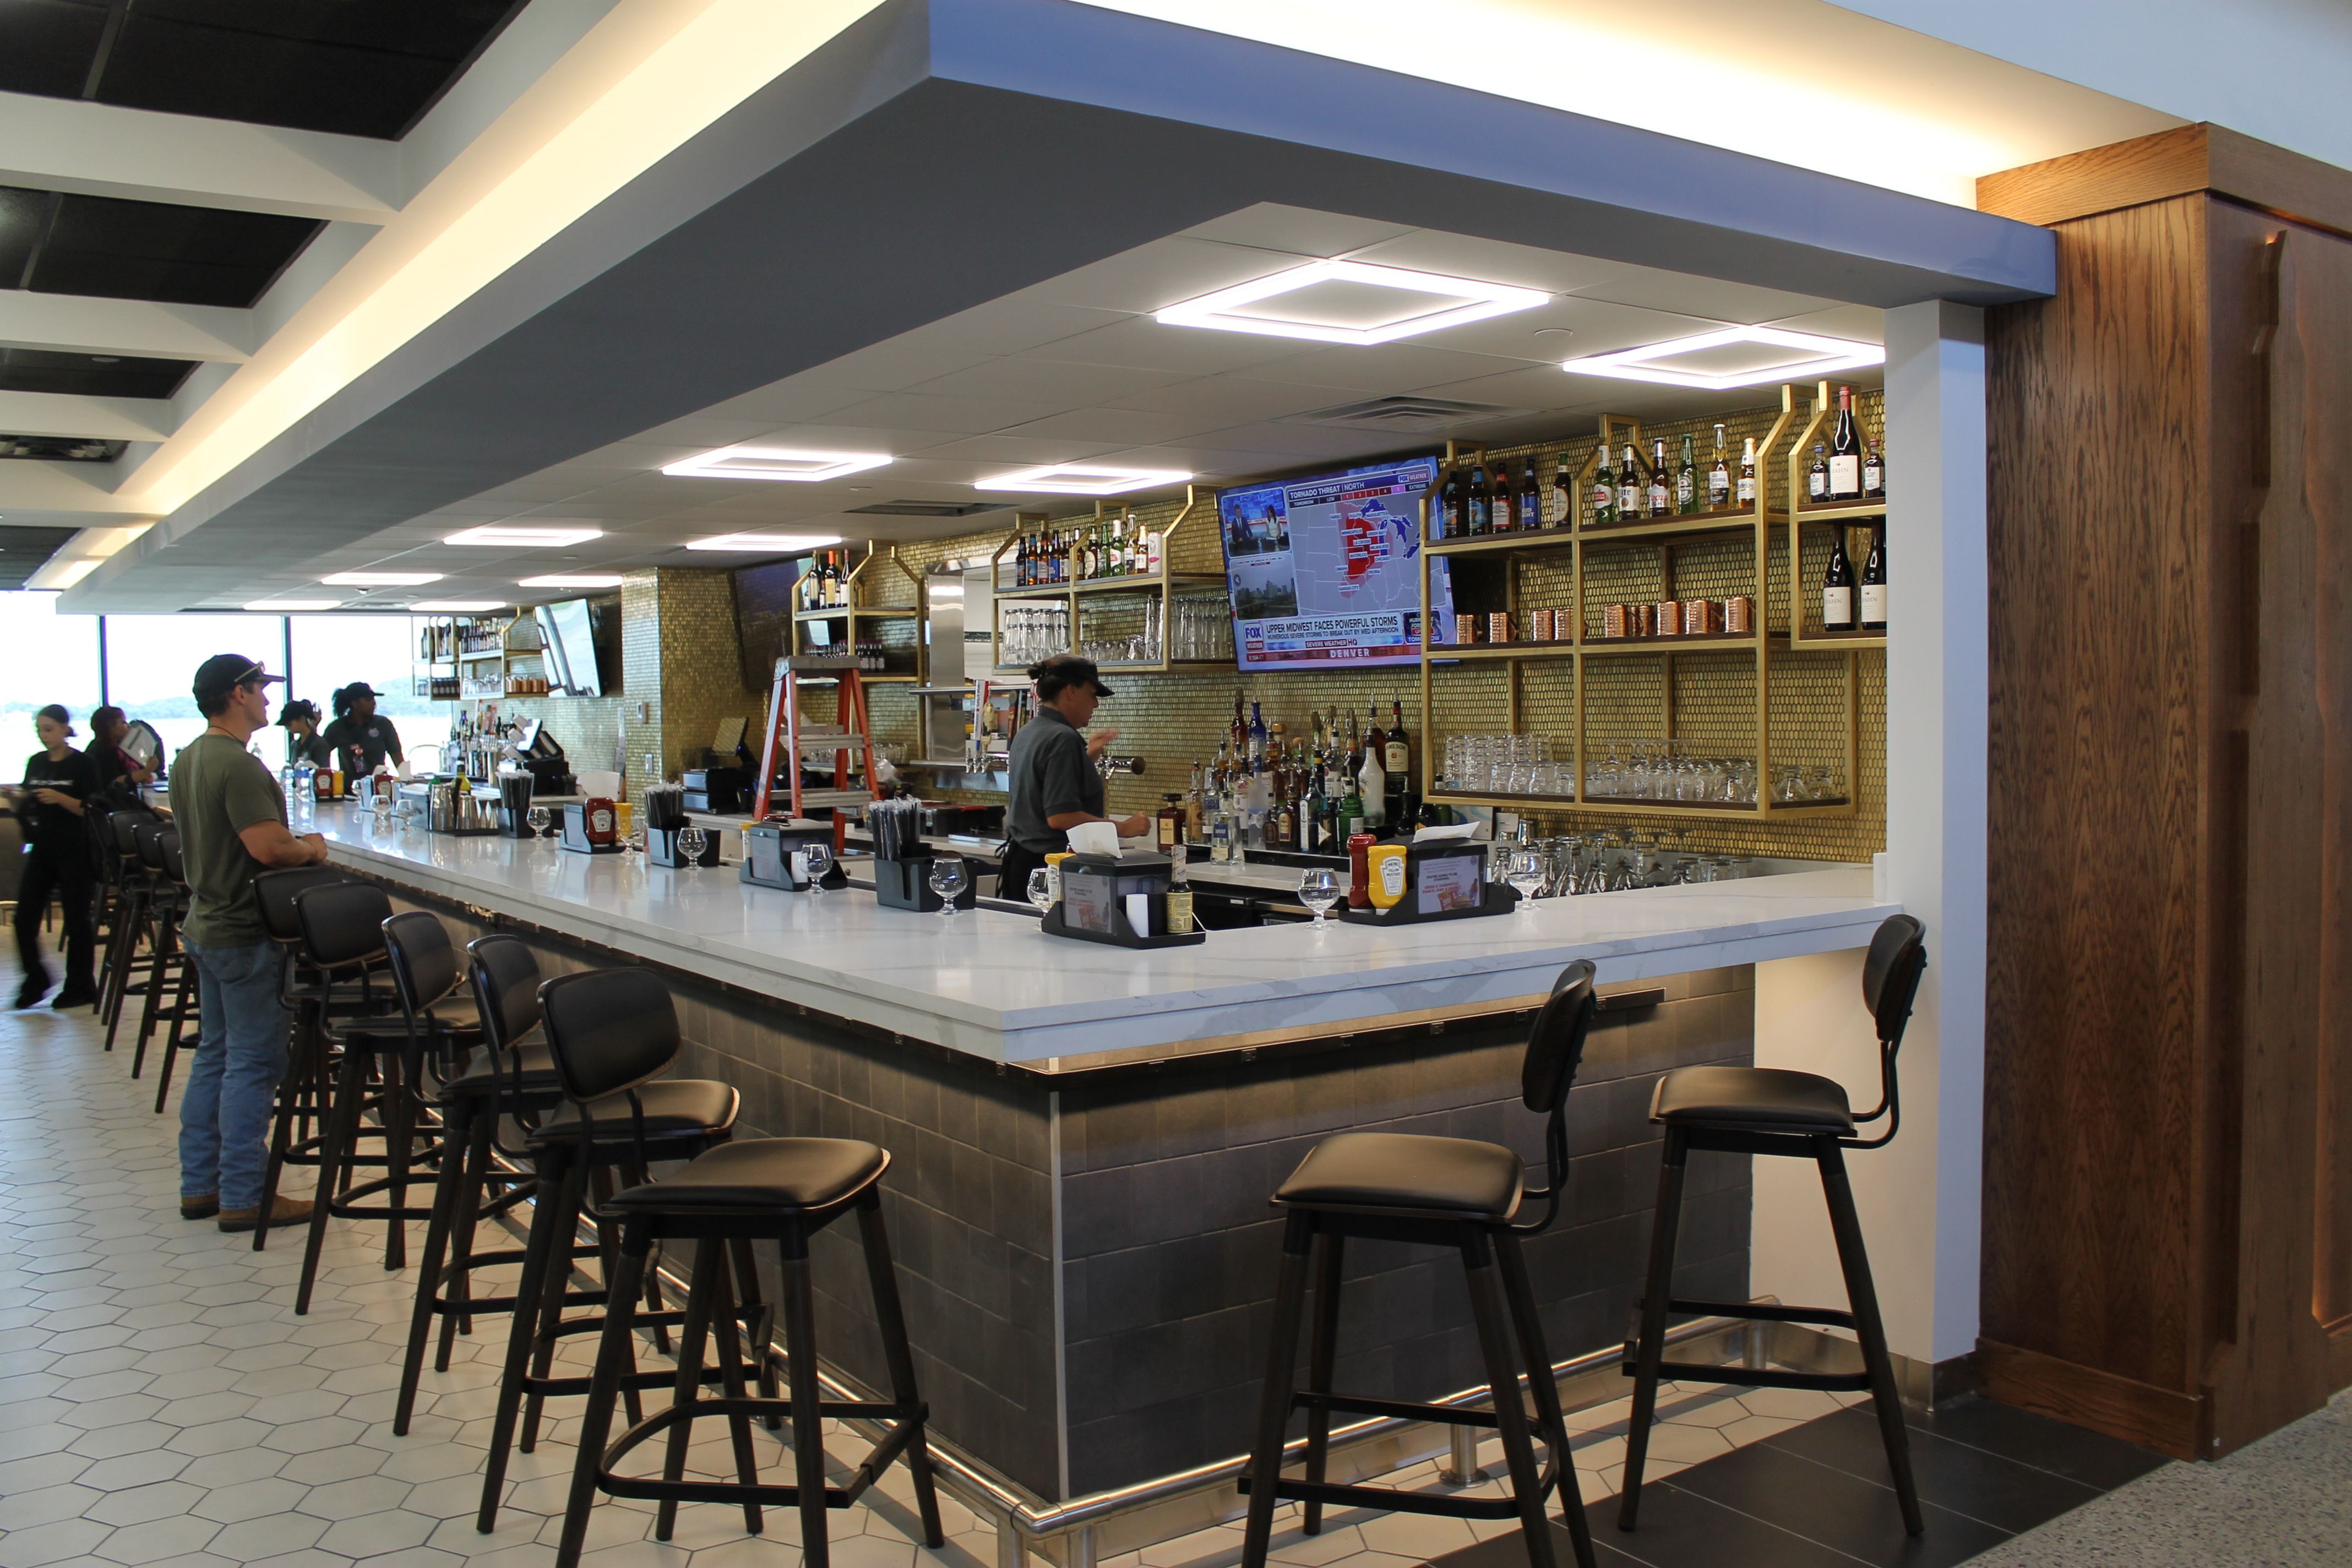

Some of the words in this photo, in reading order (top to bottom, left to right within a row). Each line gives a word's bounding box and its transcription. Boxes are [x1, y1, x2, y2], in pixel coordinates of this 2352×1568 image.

[1409, 472, 1427, 481] WEATHER
[1290, 488, 1317, 499] TORNADO
[1318, 485, 1341, 495] THREAT
[1344, 481, 1365, 491] NORTH
[1266, 624, 1286, 634] UPPER
[1286, 622, 1313, 632] MIDWEST
[1314, 620, 1334, 630] FACES
[1335, 618, 1369, 629] POWERFUL
[1370, 616, 1398, 627] STORMS
[1245, 627, 1262, 639] FOX
[1330, 648, 1370, 658] DENVER
